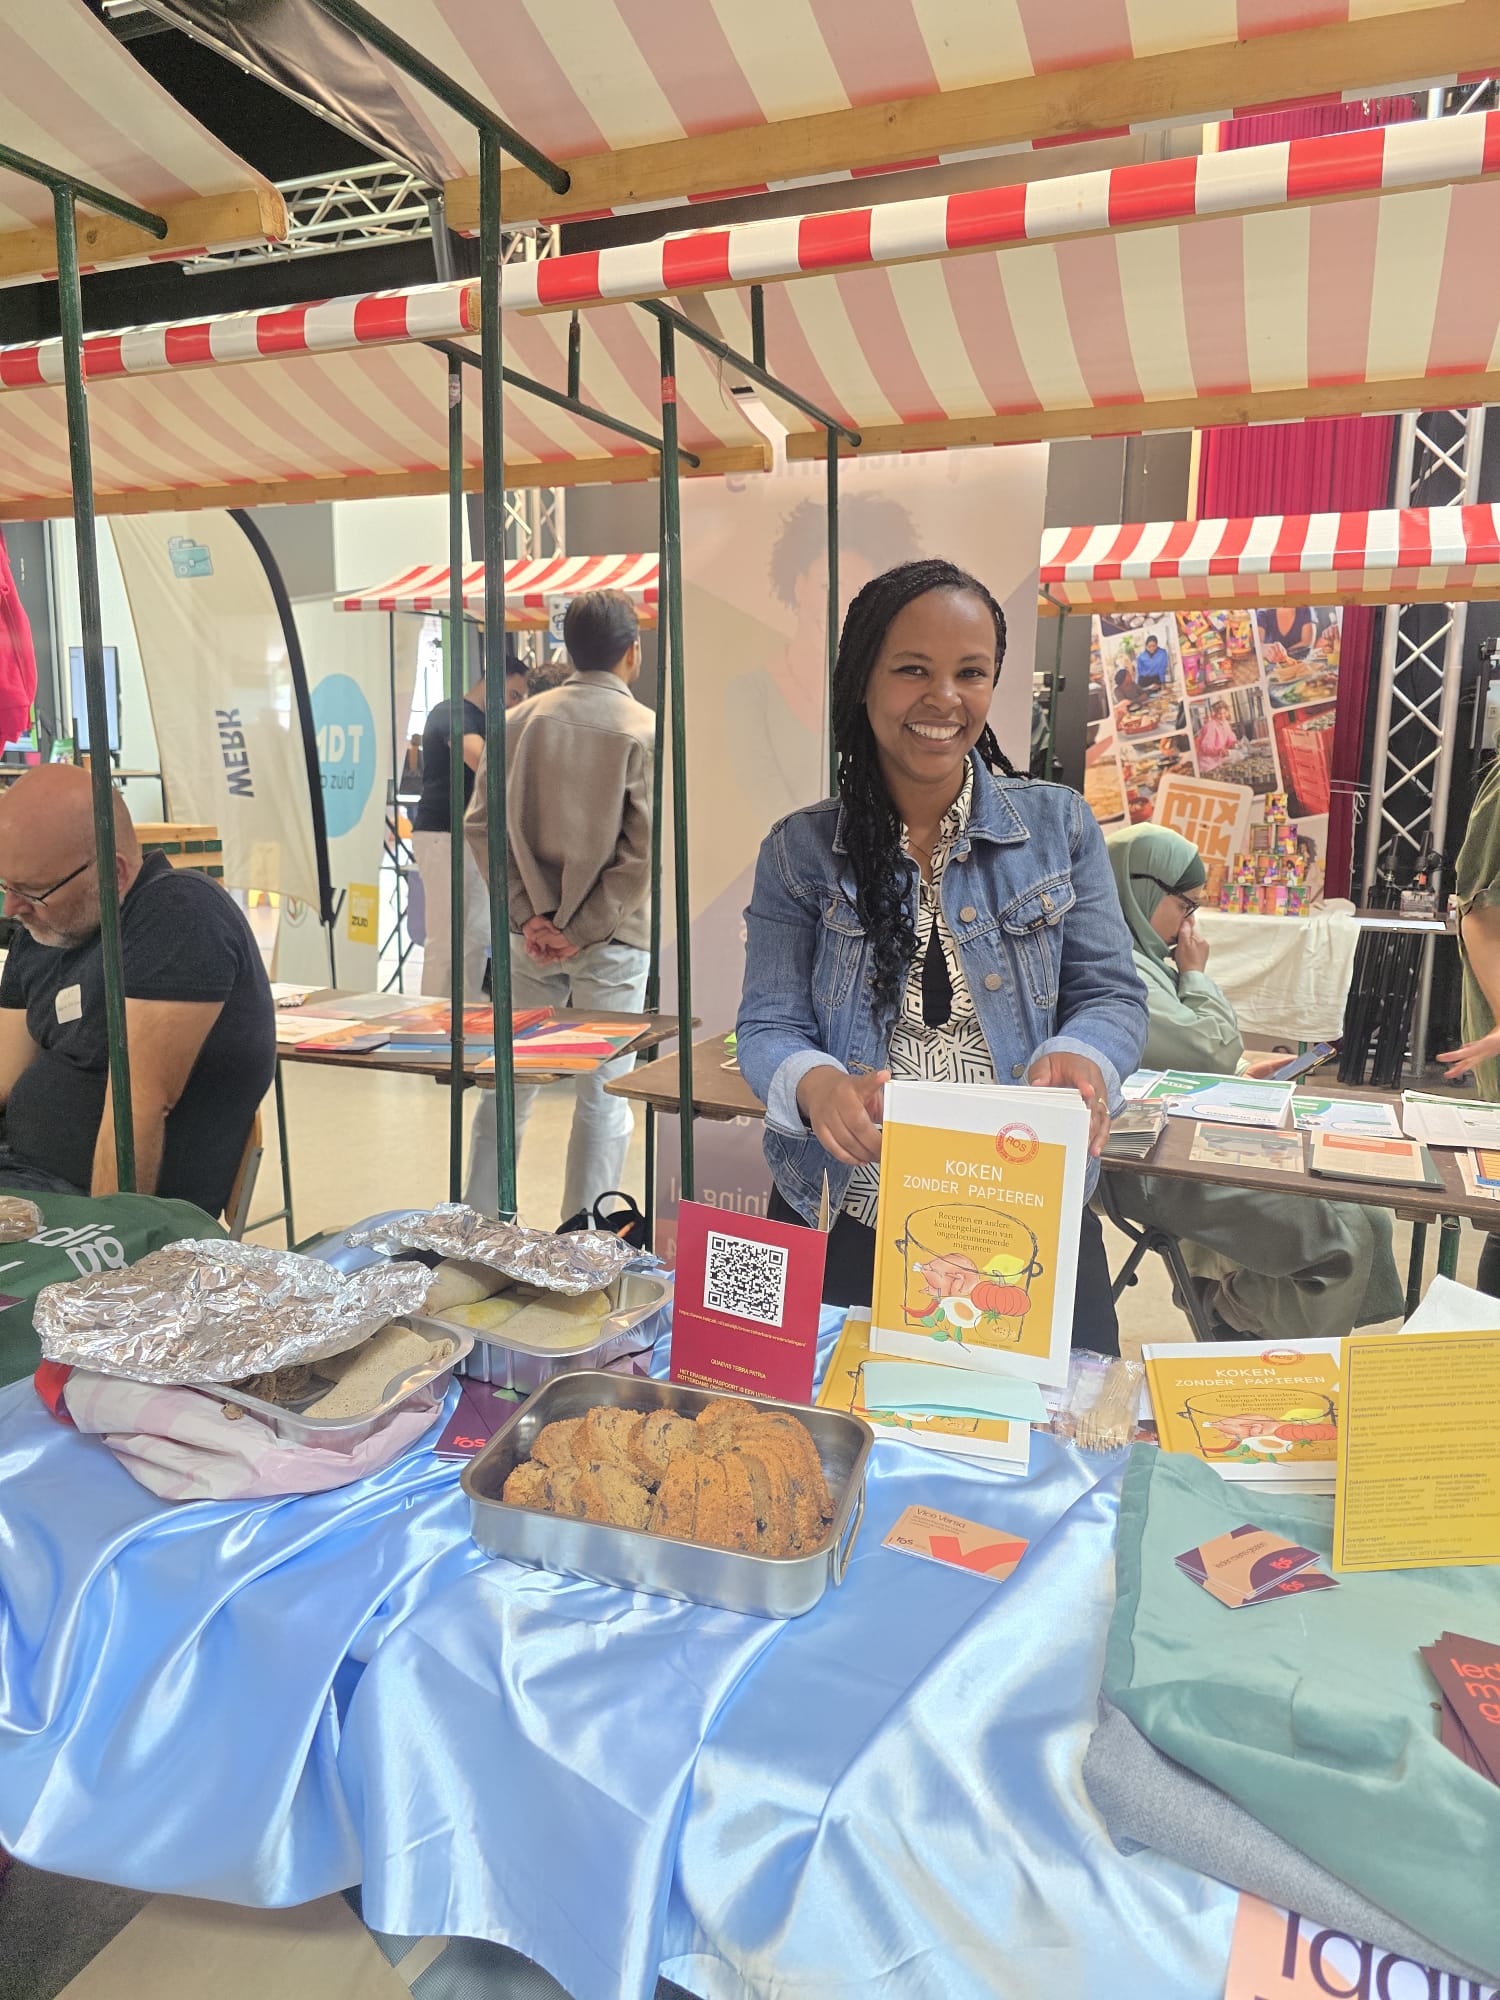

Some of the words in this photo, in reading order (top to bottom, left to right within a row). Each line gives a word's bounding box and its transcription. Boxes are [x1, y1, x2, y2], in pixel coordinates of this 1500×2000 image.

[1005, 1135, 1027, 1152] ROS
[945, 1159, 1003, 1182] KOKEN
[903, 1175, 959, 1195] ZONDER
[968, 1184, 1044, 1208] PAPIEREN
[938, 1211, 972, 1223] Recepten
[985, 1220, 1010, 1229] andere
[934, 1219, 998, 1237] keukengeheimen
[1000, 1231, 1013, 1239] van
[936, 1230, 1010, 1247] ongedocumenteerde
[953, 1241, 991, 1253] migranten
[1215, 1368, 1277, 1377] KOKEN
[1175, 1379, 1236, 1387] ZONDER
[1244, 1376, 1326, 1386] PAPIEREN
[939, 1514, 966, 1529] Versa
